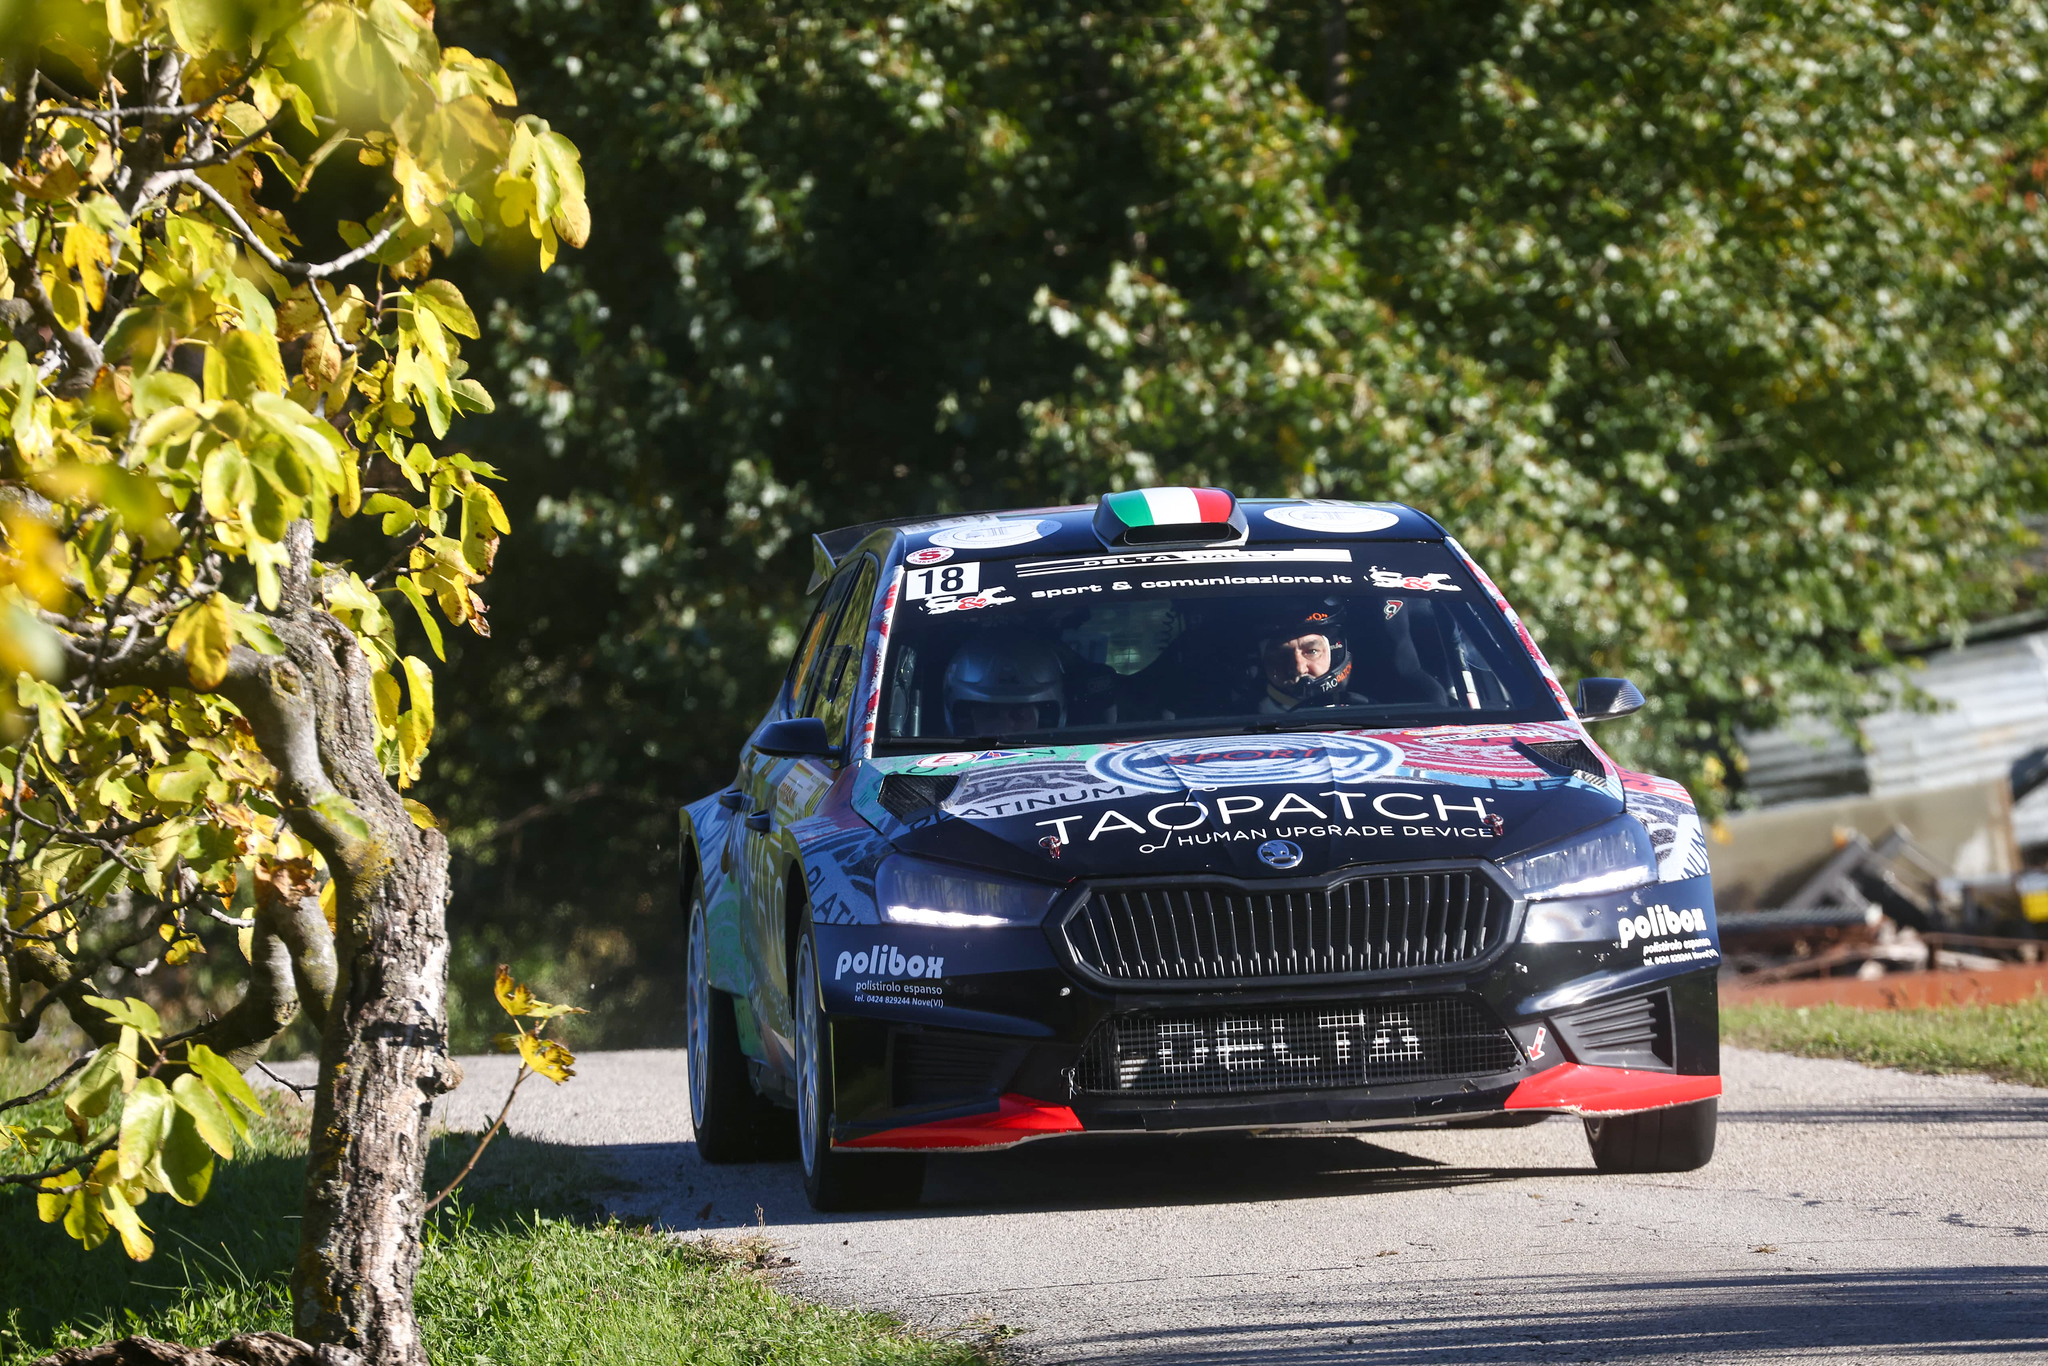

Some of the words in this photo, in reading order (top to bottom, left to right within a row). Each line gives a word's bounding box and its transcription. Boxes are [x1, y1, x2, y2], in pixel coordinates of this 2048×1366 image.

[1083, 554, 1173, 566] DELTA
[918, 567, 964, 595] 18
[1031, 583, 1103, 598] sport
[1112, 581, 1132, 591] &
[1141, 574, 1353, 588] comunicazione.it
[933, 755, 955, 765] E
[1167, 749, 1322, 765] SPORT
[1036, 792, 1488, 845] TAOPATCH
[1178, 828, 1267, 846] HUMAN
[1276, 824, 1394, 838] UPGRADE
[1402, 826, 1494, 837] DEVICE
[1618, 904, 1707, 949] polibox
[1643, 938, 1683, 956] polistirolo
[834, 944, 945, 981] polibox
[855, 980, 901, 992] polistirolo
[903, 985, 943, 995] espanso
[854, 994, 865, 1003] tel.
[866, 996, 884, 1004] 0424
[885, 996, 911, 1005] 829244
[911, 997, 944, 1008] Nove(VI)
[1158, 1012, 1428, 1074] DELTA
